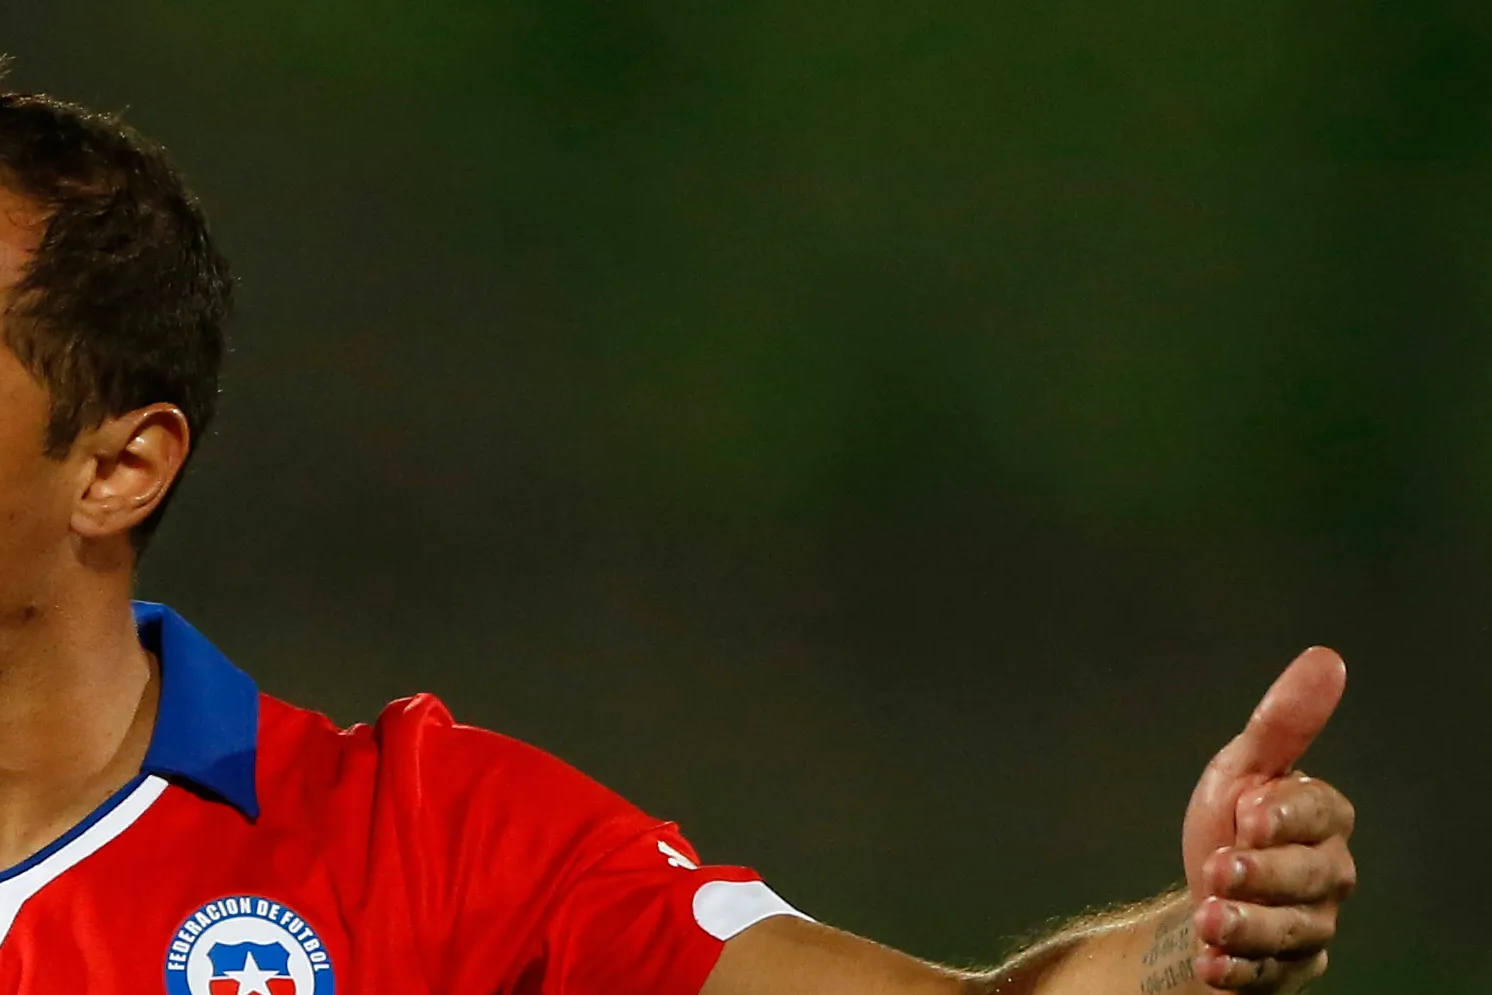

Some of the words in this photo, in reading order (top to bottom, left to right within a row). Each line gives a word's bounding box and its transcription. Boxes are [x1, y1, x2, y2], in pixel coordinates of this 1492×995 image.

[168, 898, 251, 971] FEDERACION
[256, 899, 280, 921] DE
[280, 911, 330, 972] FUTBOL
